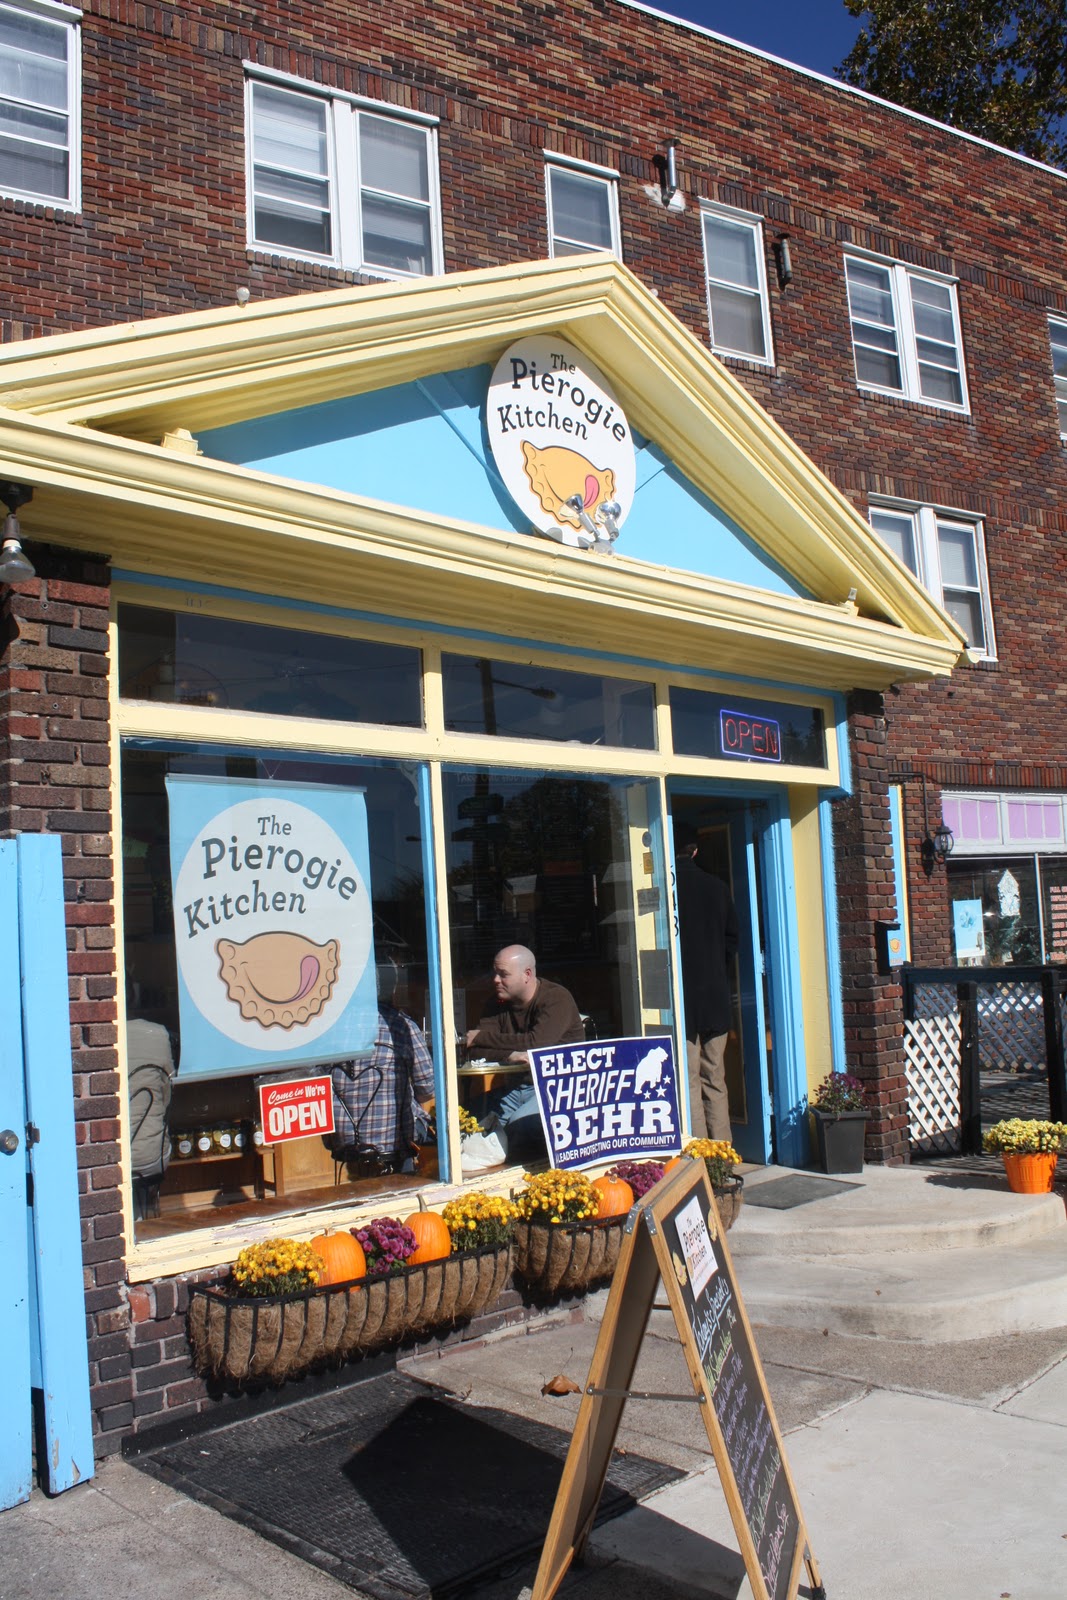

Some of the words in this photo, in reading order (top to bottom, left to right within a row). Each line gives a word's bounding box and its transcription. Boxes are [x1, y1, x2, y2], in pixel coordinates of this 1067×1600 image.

[550, 353, 576, 375] The
[509, 358, 626, 442] Pierogie
[497, 402, 588, 440] Kitchen
[725, 718, 778, 755] OPEN
[257, 814, 292, 836] The
[201, 835, 358, 900] Pierogie
[183, 879, 306, 939] Kitchen
[539, 1046, 616, 1078] ELECT
[267, 1090, 294, 1105] Come
[294, 1087, 304, 1097] in
[304, 1084, 326, 1098] We're
[546, 1069, 635, 1113] SHERIFF
[268, 1099, 328, 1137] OPEN
[550, 1100, 675, 1151] BEHR
[580, 1140, 611, 1158] PROTECTING
[612, 1138, 628, 1149] OUR
[629, 1134, 676, 1146] COMMUNITY
[682, 1218, 706, 1253] Pierogie
